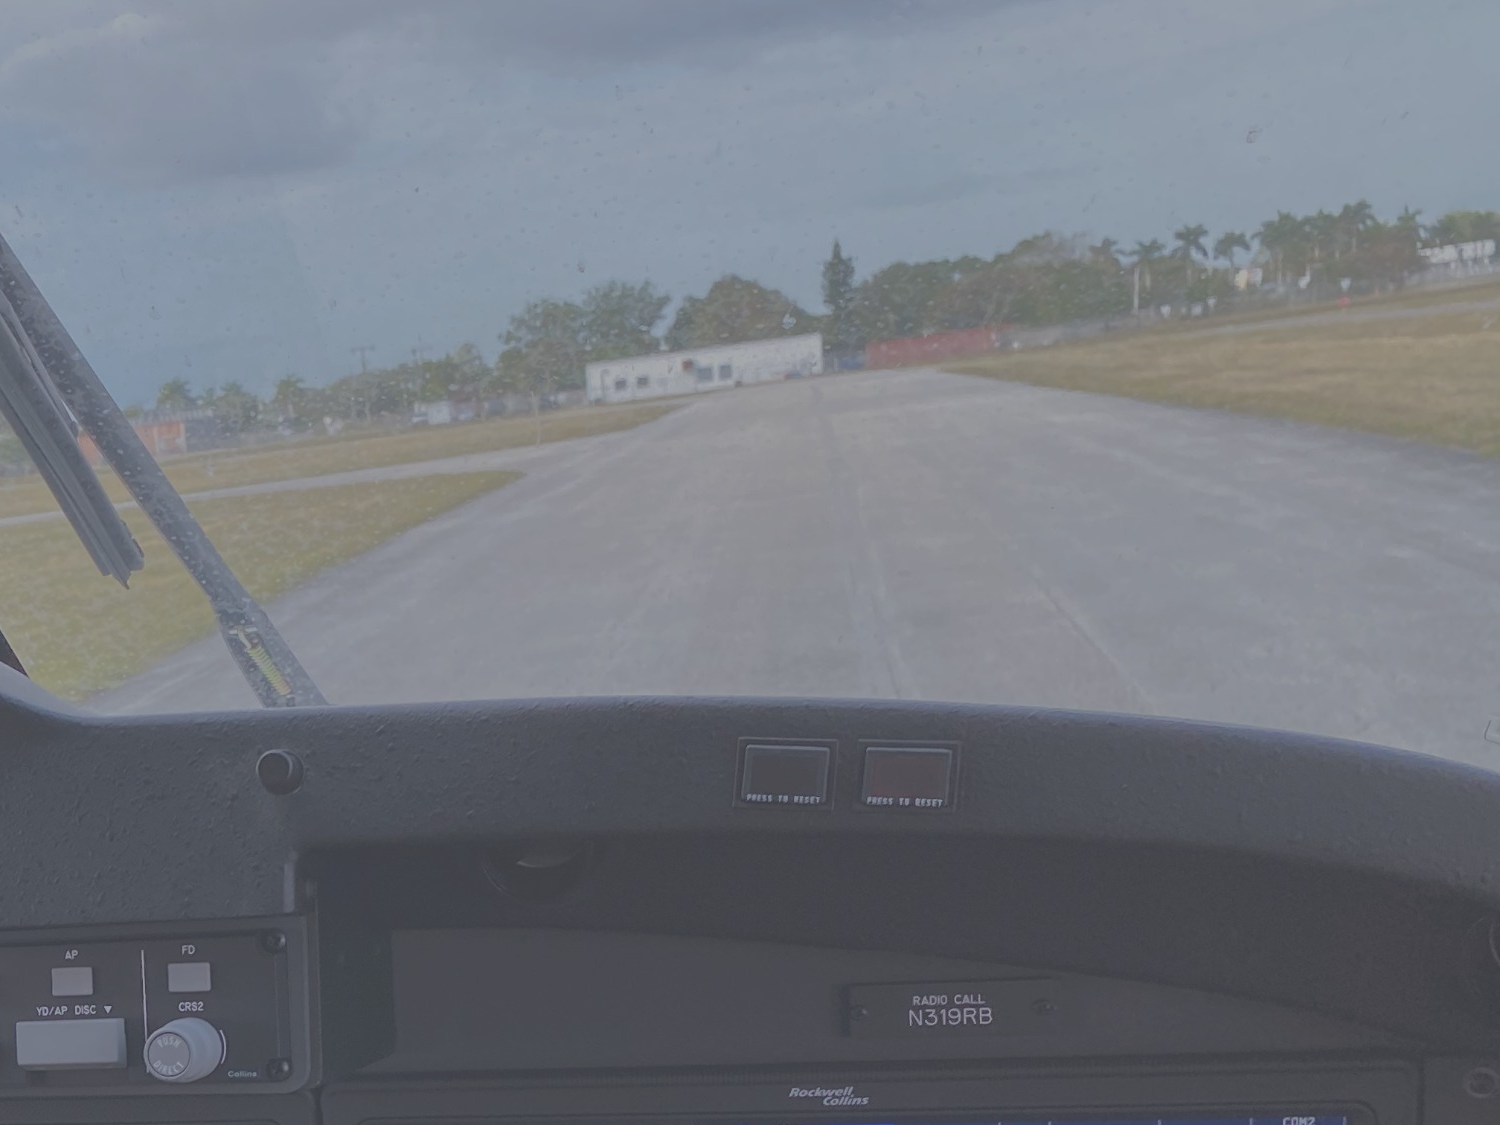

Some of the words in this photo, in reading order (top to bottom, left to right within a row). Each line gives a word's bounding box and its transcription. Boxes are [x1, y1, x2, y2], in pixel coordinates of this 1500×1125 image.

[64, 950, 79, 960] AP
[181, 945, 196, 956] FD
[912, 994, 948, 1006] RADIO
[953, 993, 986, 1004] CALL
[36, 1005, 68, 1017] YD/AP
[74, 1004, 97, 1016] DISC
[178, 1001, 204, 1013] CRS2
[908, 1007, 993, 1027] N319RB
[789, 1086, 855, 1099] Rockwell
[822, 1095, 870, 1106] Collins
